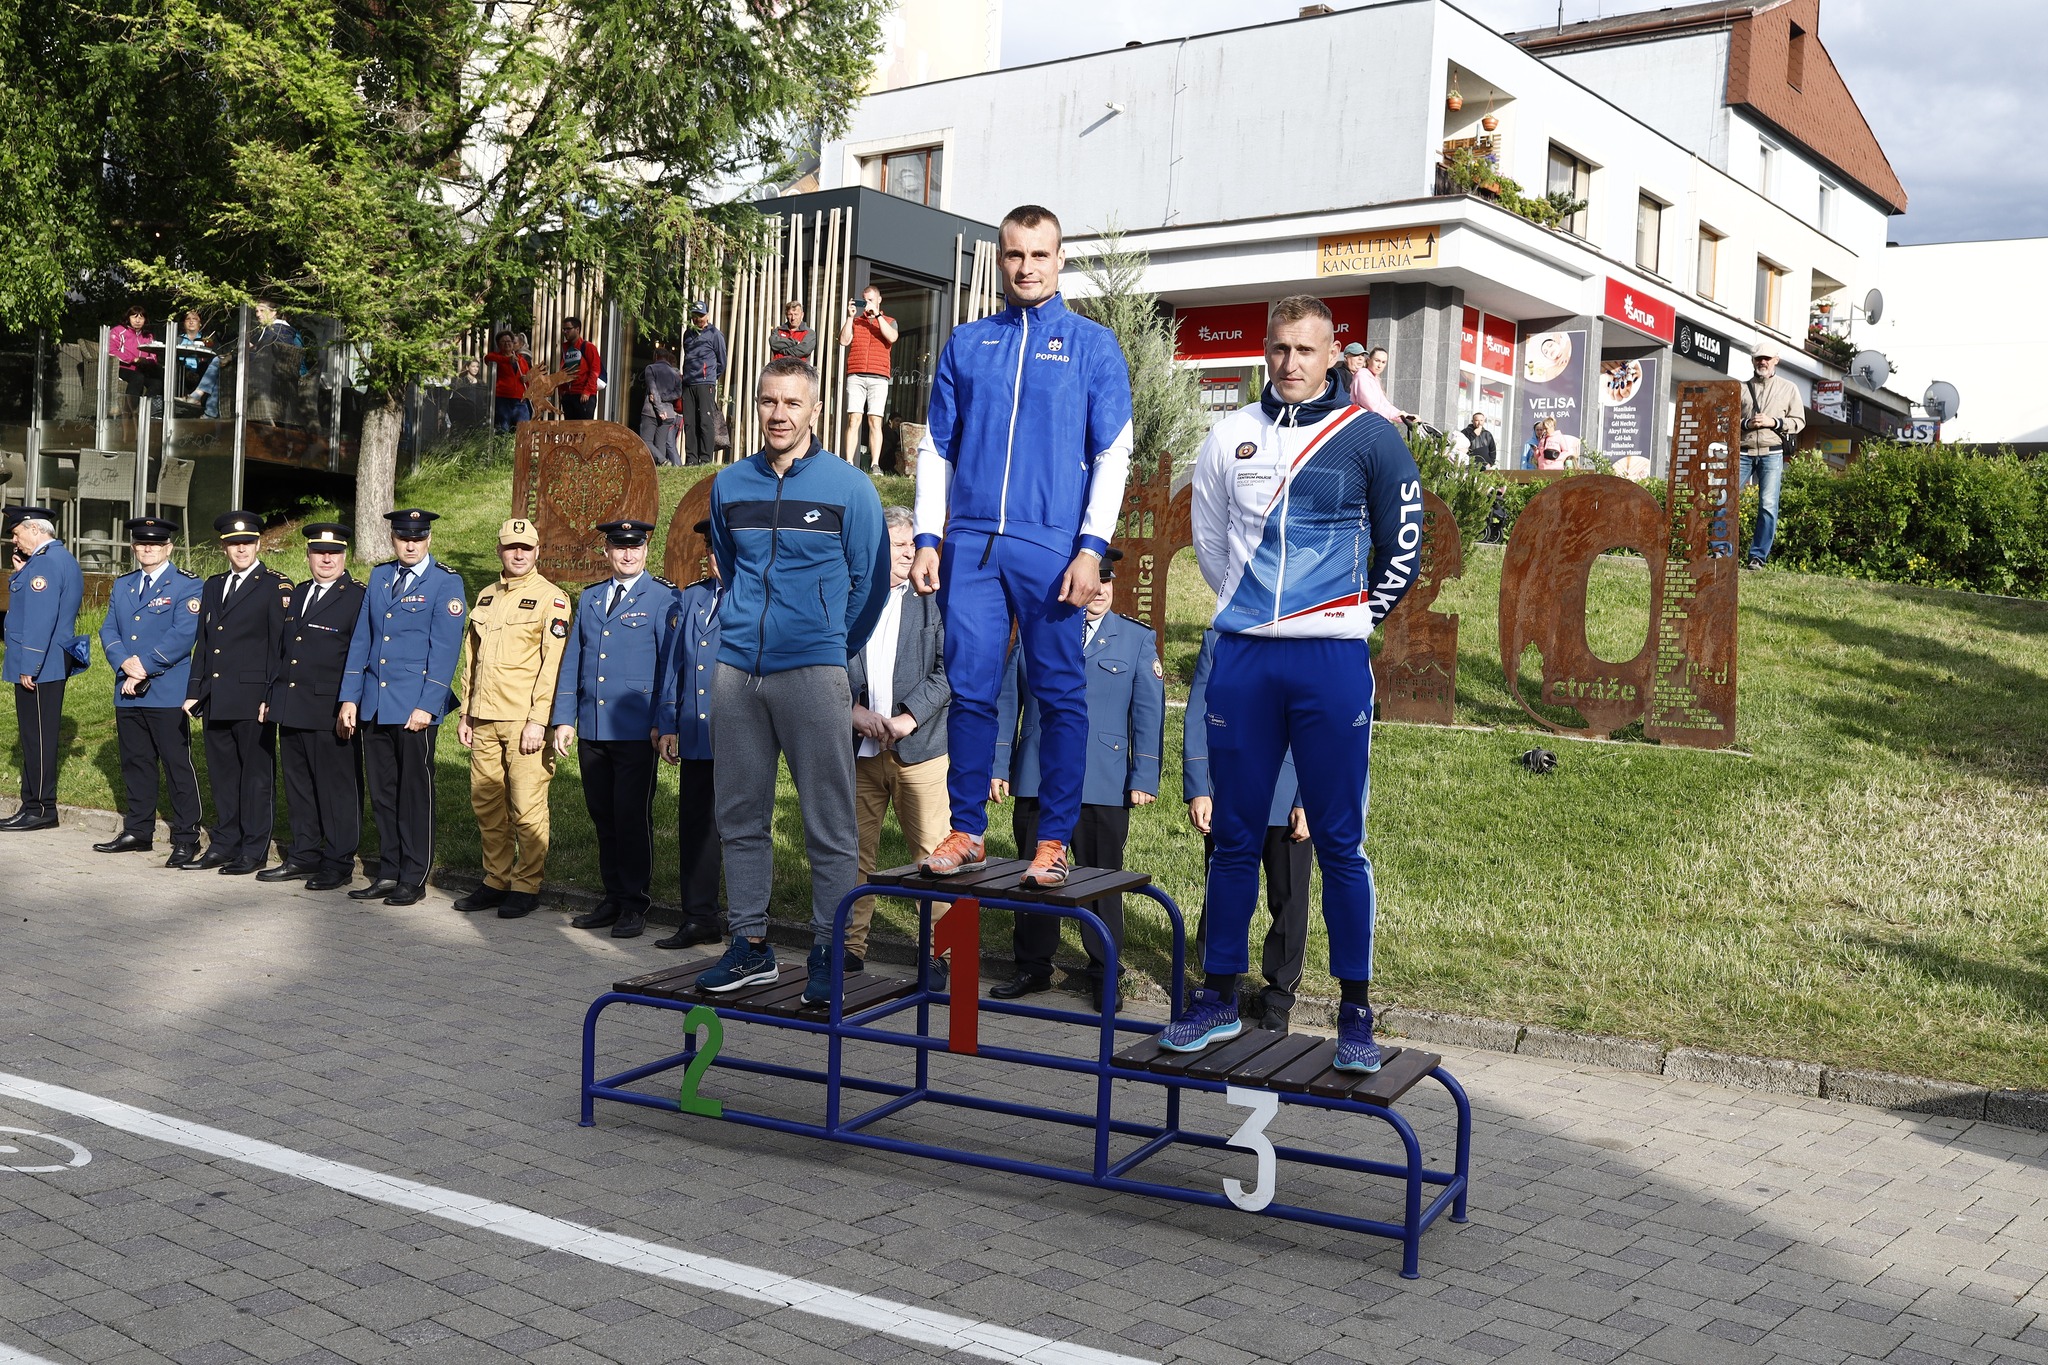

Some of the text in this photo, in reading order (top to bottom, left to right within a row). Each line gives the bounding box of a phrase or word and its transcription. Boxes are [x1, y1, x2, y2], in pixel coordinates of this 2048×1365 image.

[1323, 233, 1412, 257] REALITNÁ
[1322, 254, 1412, 273] KANCELÁRIA
[1628, 307, 1655, 329] SATUR
[1203, 330, 1243, 342] SATUR
[1694, 331, 1721, 356] VELISA
[1035, 352, 1070, 363] POPRAD
[1488, 341, 1511, 357] SATUR
[1529, 397, 1576, 409] VELISA
[1533, 411, 1549, 419] NAIL
[1556, 410, 1570, 418] SPA
[1369, 480, 1422, 628] SLOVAK
[1552, 676, 1637, 701] stráže
[933, 898, 980, 1056] 1
[680, 1005, 725, 1118] 2
[1222, 1086, 1279, 1212] 3
